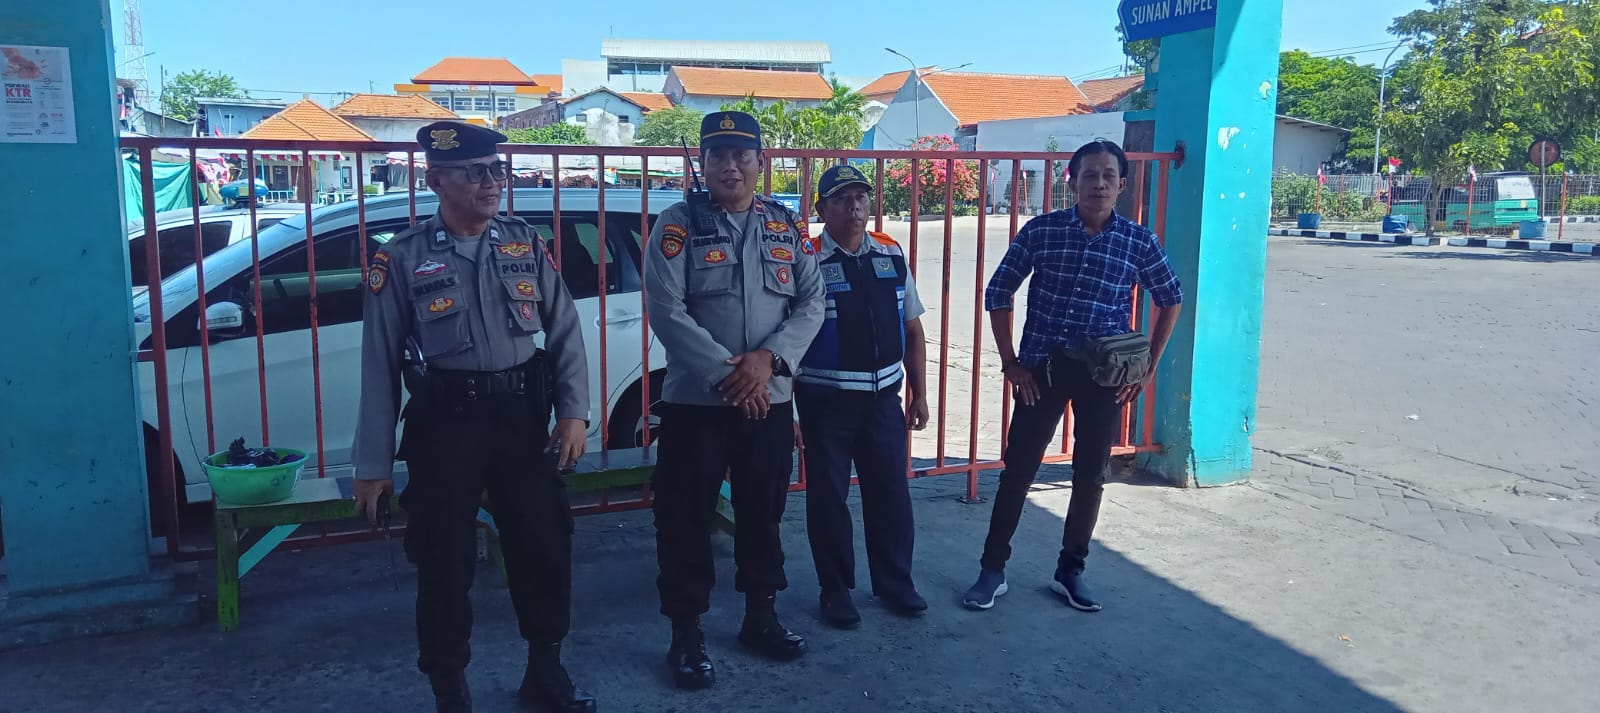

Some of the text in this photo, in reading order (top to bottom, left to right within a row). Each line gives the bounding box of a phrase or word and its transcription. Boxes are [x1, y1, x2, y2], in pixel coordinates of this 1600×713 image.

[1131, 0, 1170, 25] SUNAN
[5, 87, 31, 97] KTR
[762, 233, 794, 245] POLRI
[501, 262, 536, 275] POLRI
